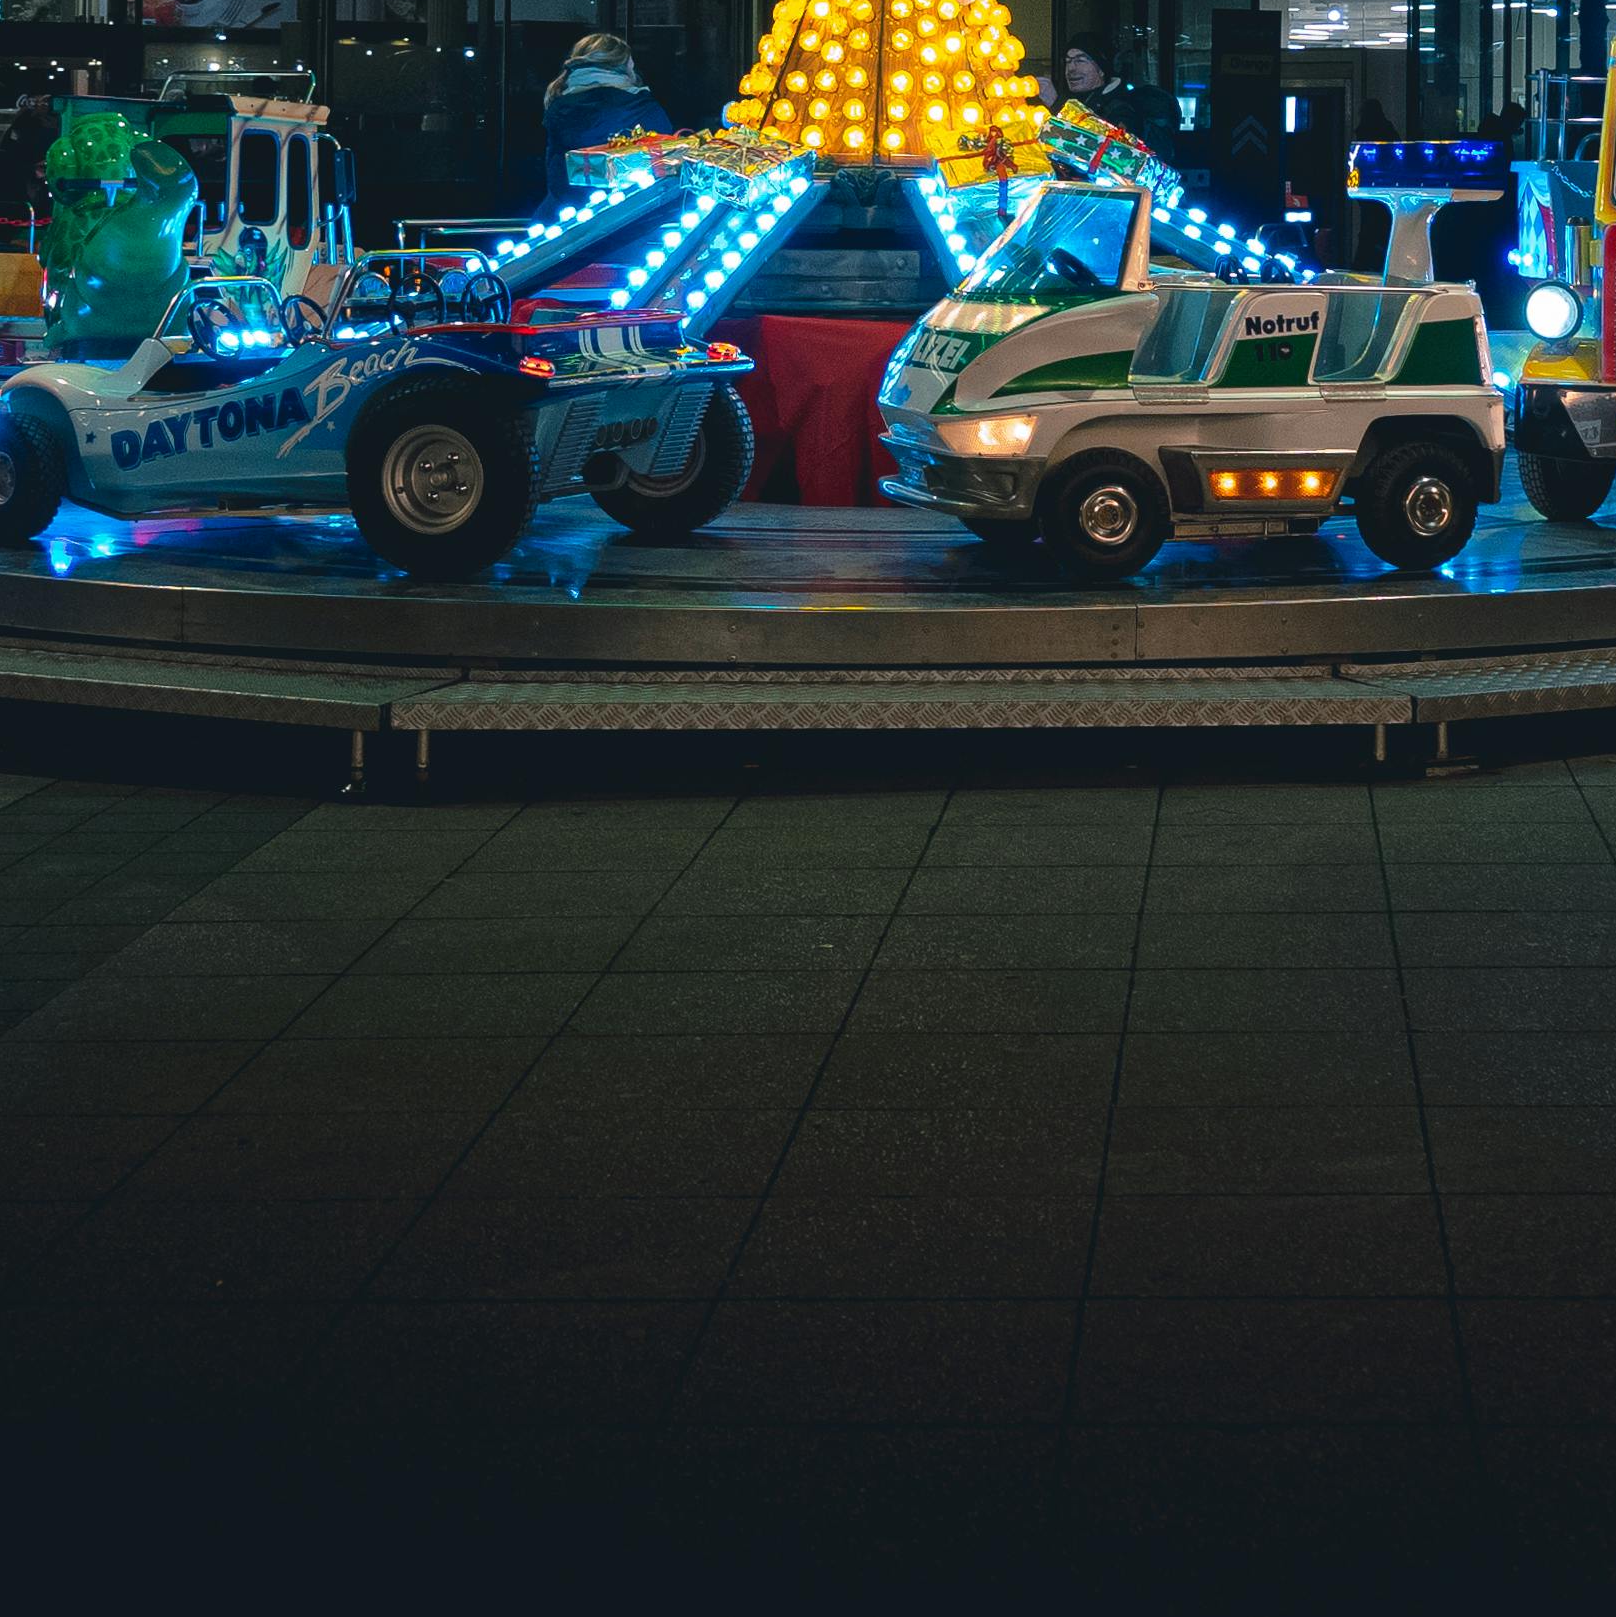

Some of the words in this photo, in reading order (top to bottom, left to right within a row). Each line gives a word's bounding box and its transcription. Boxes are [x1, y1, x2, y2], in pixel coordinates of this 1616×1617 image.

[1245, 311, 1320, 336] Notruf
[1254, 341, 1294, 362] 110
[110, 386, 310, 471] DAYTONA
[276, 340, 445, 459] Beach
